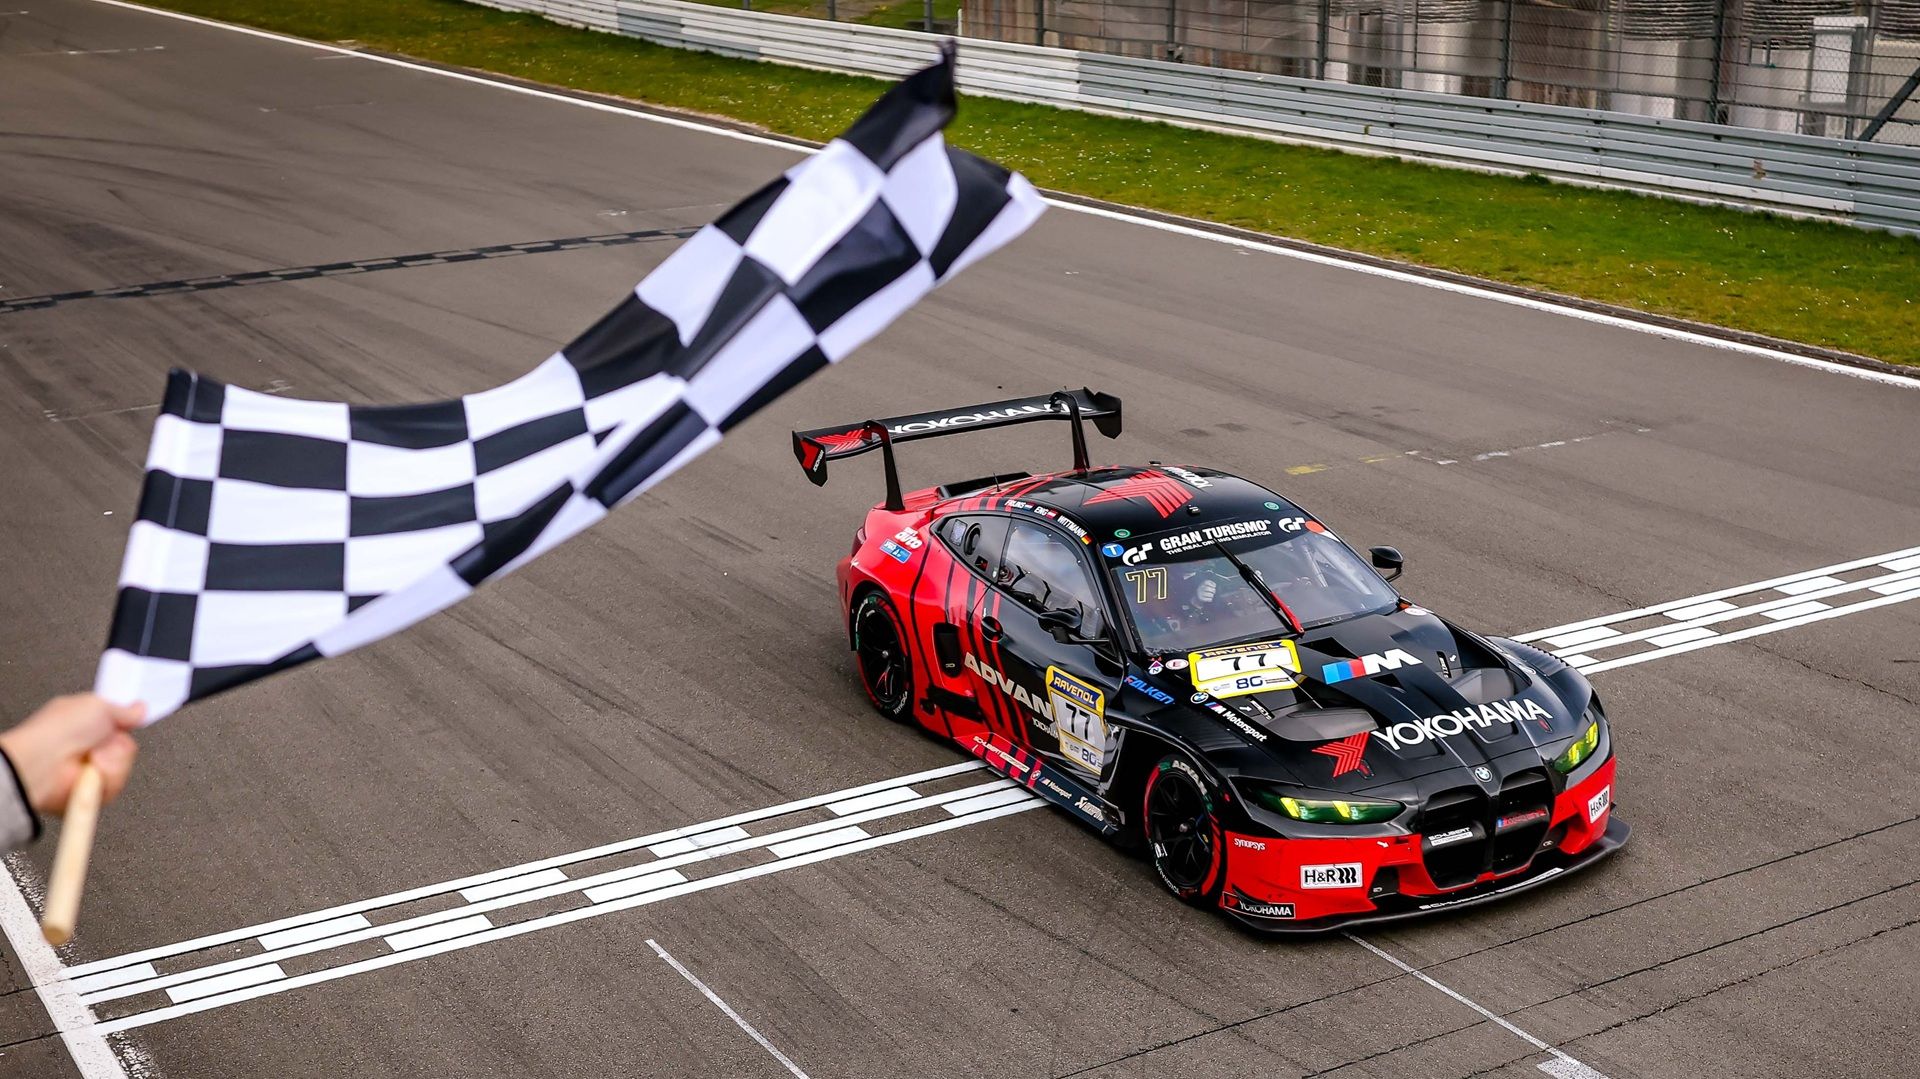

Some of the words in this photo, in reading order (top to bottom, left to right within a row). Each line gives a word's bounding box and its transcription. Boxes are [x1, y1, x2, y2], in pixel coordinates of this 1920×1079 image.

[1034, 506, 1049, 516] ENG
[1057, 515, 1087, 538] WITTMANN
[1159, 532, 1202, 551] GRAN
[1202, 519, 1268, 540] TURISMO
[1166, 548, 1183, 556] THE
[1183, 544, 1202, 554] REAL
[1202, 536, 1232, 548] DRIING
[1232, 530, 1272, 542] SIMULATOR
[1125, 567, 1167, 604] 77
[1206, 643, 1278, 658] RAVENOL
[1221, 653, 1267, 671] 77
[964, 651, 1054, 722] ADVAN
[1053, 676, 1095, 705] RAVENOL
[1124, 675, 1174, 704] FALKEN
[1065, 702, 1091, 741] 77
[1223, 710, 1268, 742] Motorsport
[1371, 699, 1553, 751] YOKOHAMA
[1428, 827, 1471, 841] SCHUBERT
[1304, 869, 1336, 883] H&R
[1239, 900, 1293, 916] YOKOHAMA
